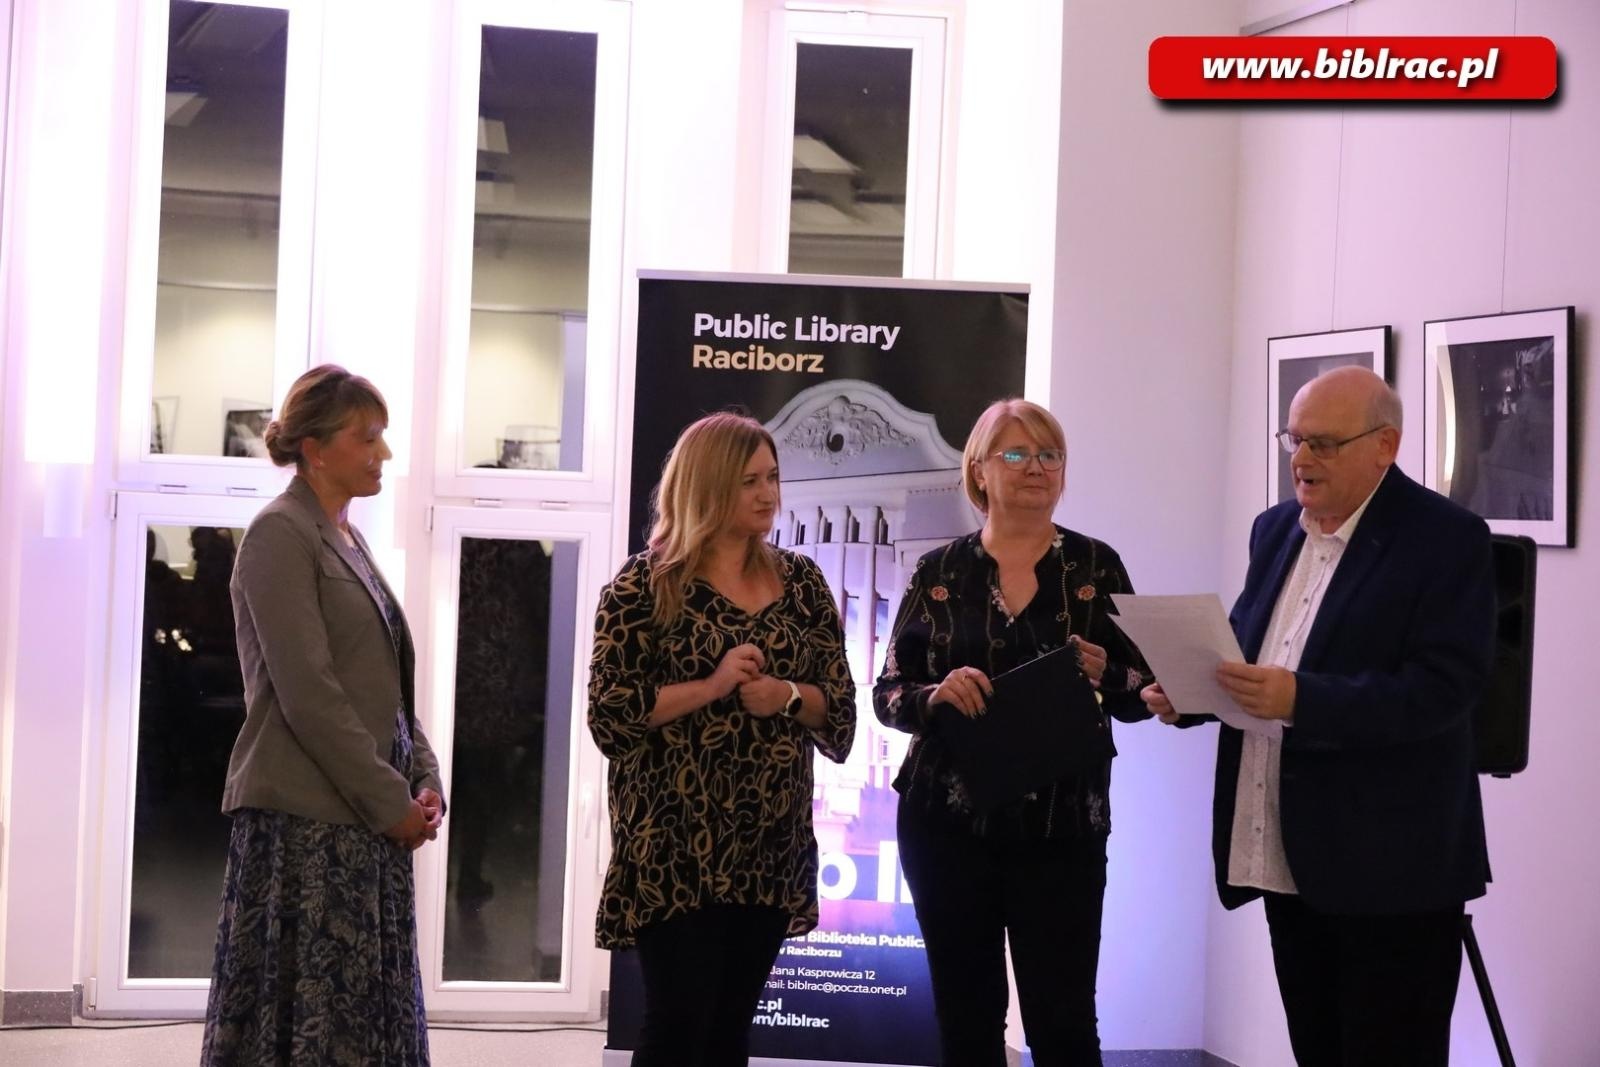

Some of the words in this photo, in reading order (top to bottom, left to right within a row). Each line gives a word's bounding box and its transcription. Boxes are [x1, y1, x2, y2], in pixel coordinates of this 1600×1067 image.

[693, 313, 787, 340] Public
[794, 317, 900, 351] Library
[692, 345, 824, 373] Raciborz
[808, 931, 876, 945] Biblioteka
[787, 946, 842, 957] Raciborzu
[797, 967, 862, 980] Kasprowicza
[865, 970, 876, 980] 12
[788, 980, 907, 996] biblrac@poczta.onet.pl
